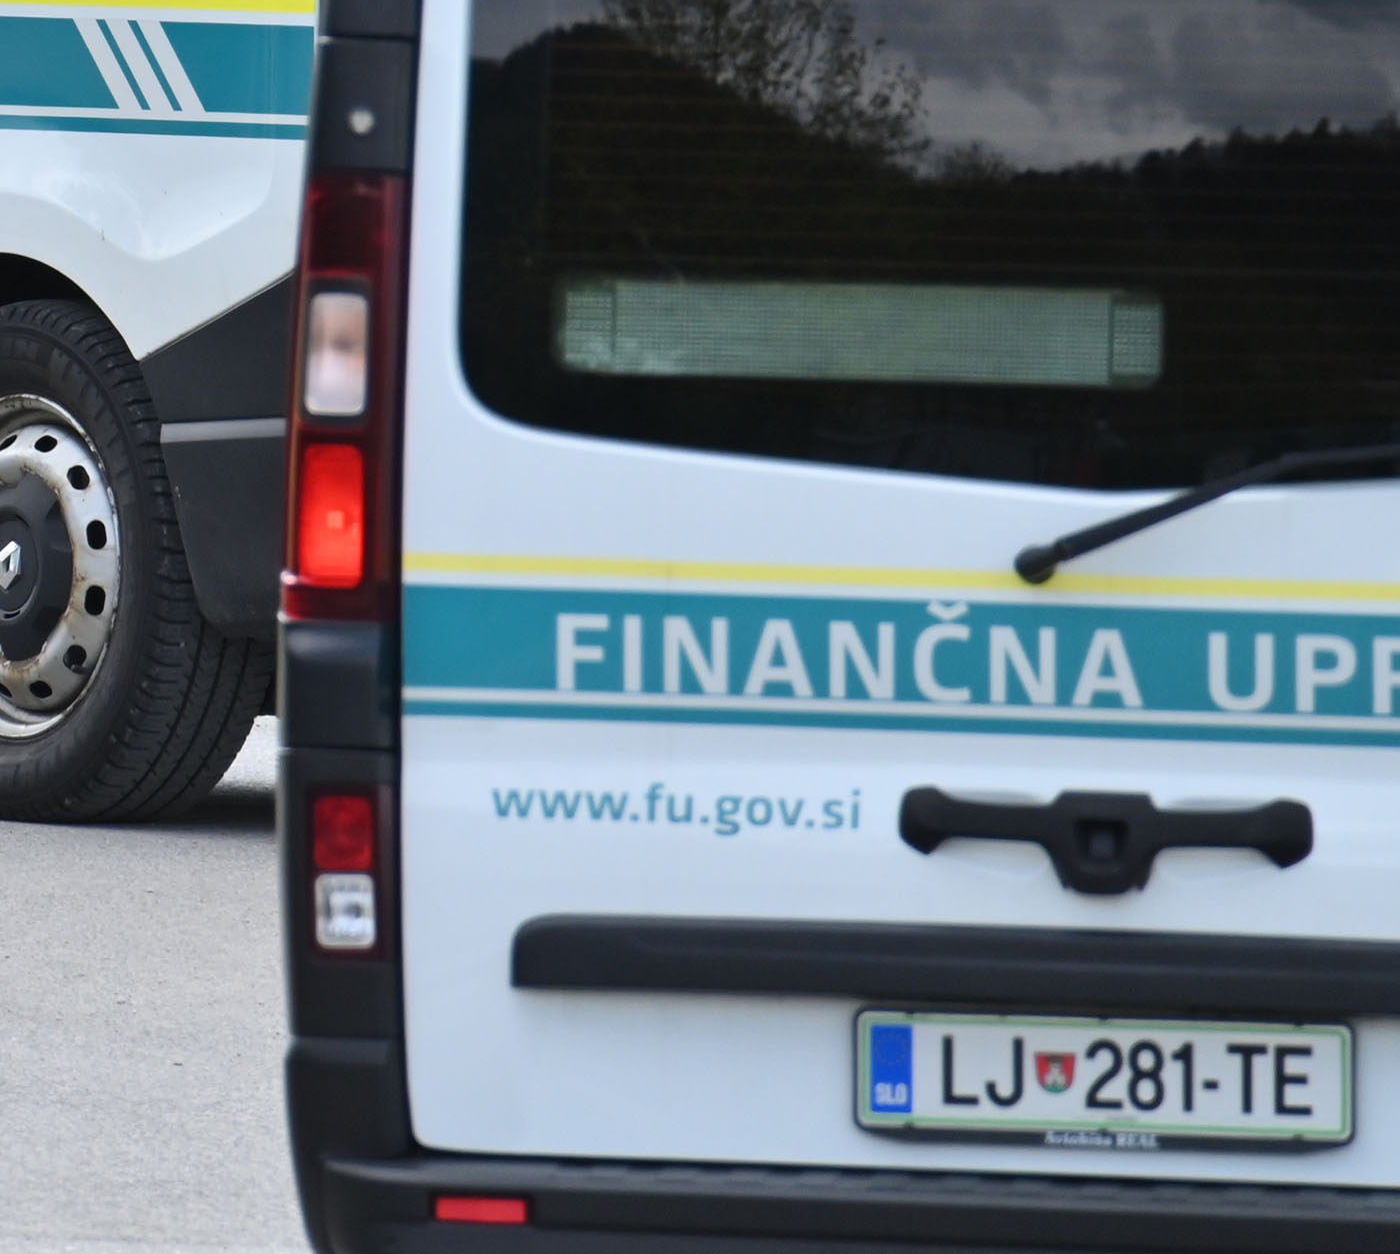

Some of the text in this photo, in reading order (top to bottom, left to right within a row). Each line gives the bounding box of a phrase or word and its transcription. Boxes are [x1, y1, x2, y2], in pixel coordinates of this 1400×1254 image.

[554, 599, 1145, 708] FINANČNA
[492, 782, 862, 836] www.fu.gov.si
[875, 1082, 908, 1106] SLO
[942, 1034, 1313, 1116] LJ 281-TE
